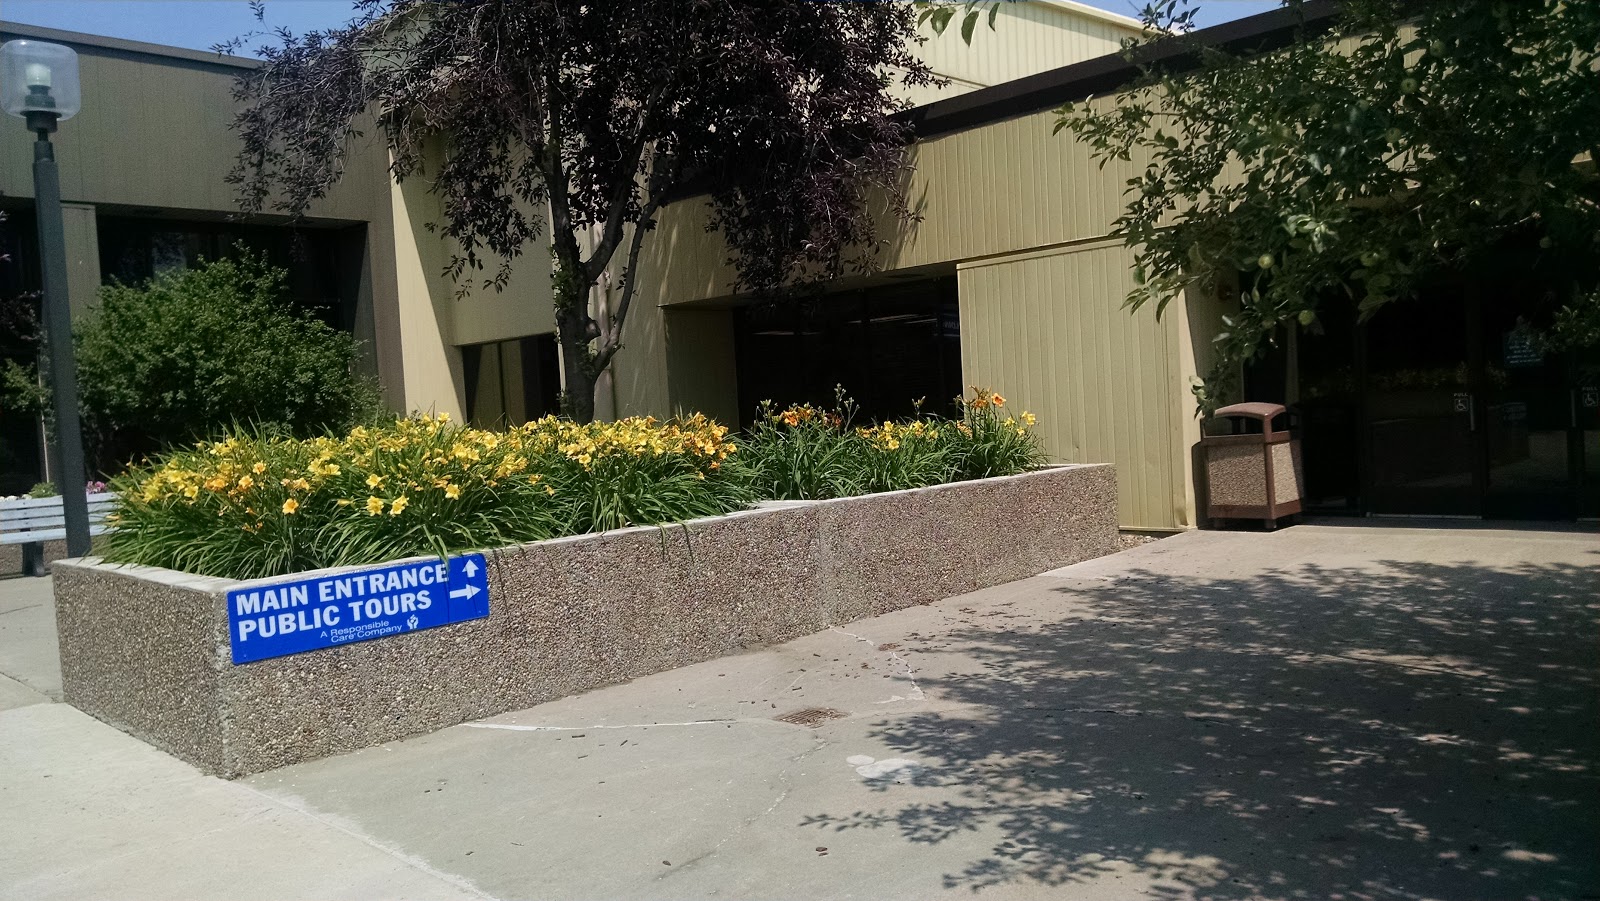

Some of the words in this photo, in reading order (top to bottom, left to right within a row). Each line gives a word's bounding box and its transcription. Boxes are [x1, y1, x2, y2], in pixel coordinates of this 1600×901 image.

[236, 585, 309, 616] MAIN
[318, 563, 449, 603] ENTRANCE
[238, 606, 341, 642] PUBLIC
[348, 589, 432, 622] TOURS
[320, 630, 328, 639] A
[330, 620, 390, 637] Responsible
[356, 624, 402, 639] Company
